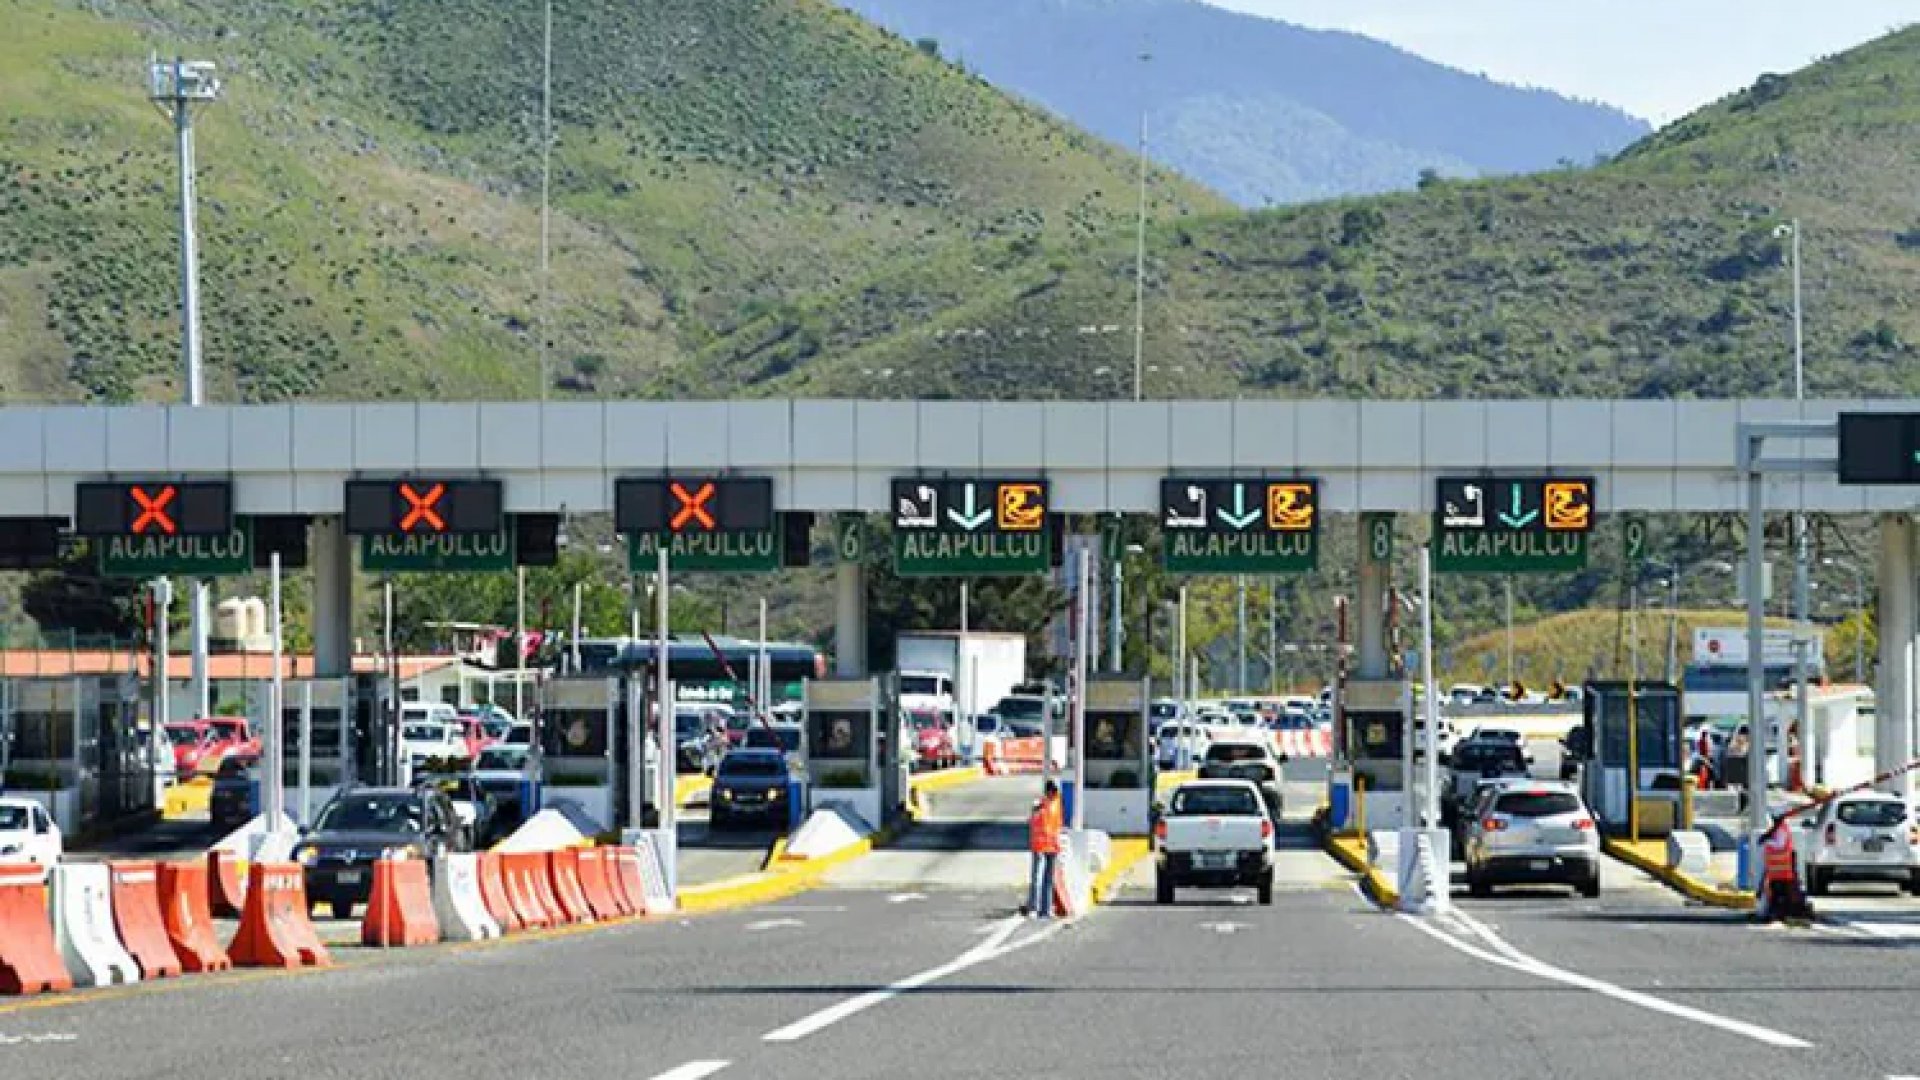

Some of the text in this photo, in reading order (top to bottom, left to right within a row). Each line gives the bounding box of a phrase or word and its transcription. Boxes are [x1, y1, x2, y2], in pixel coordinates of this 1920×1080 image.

[844, 523, 859, 557] 6
[1373, 520, 1387, 559] 8
[1626, 521, 1642, 557] 9
